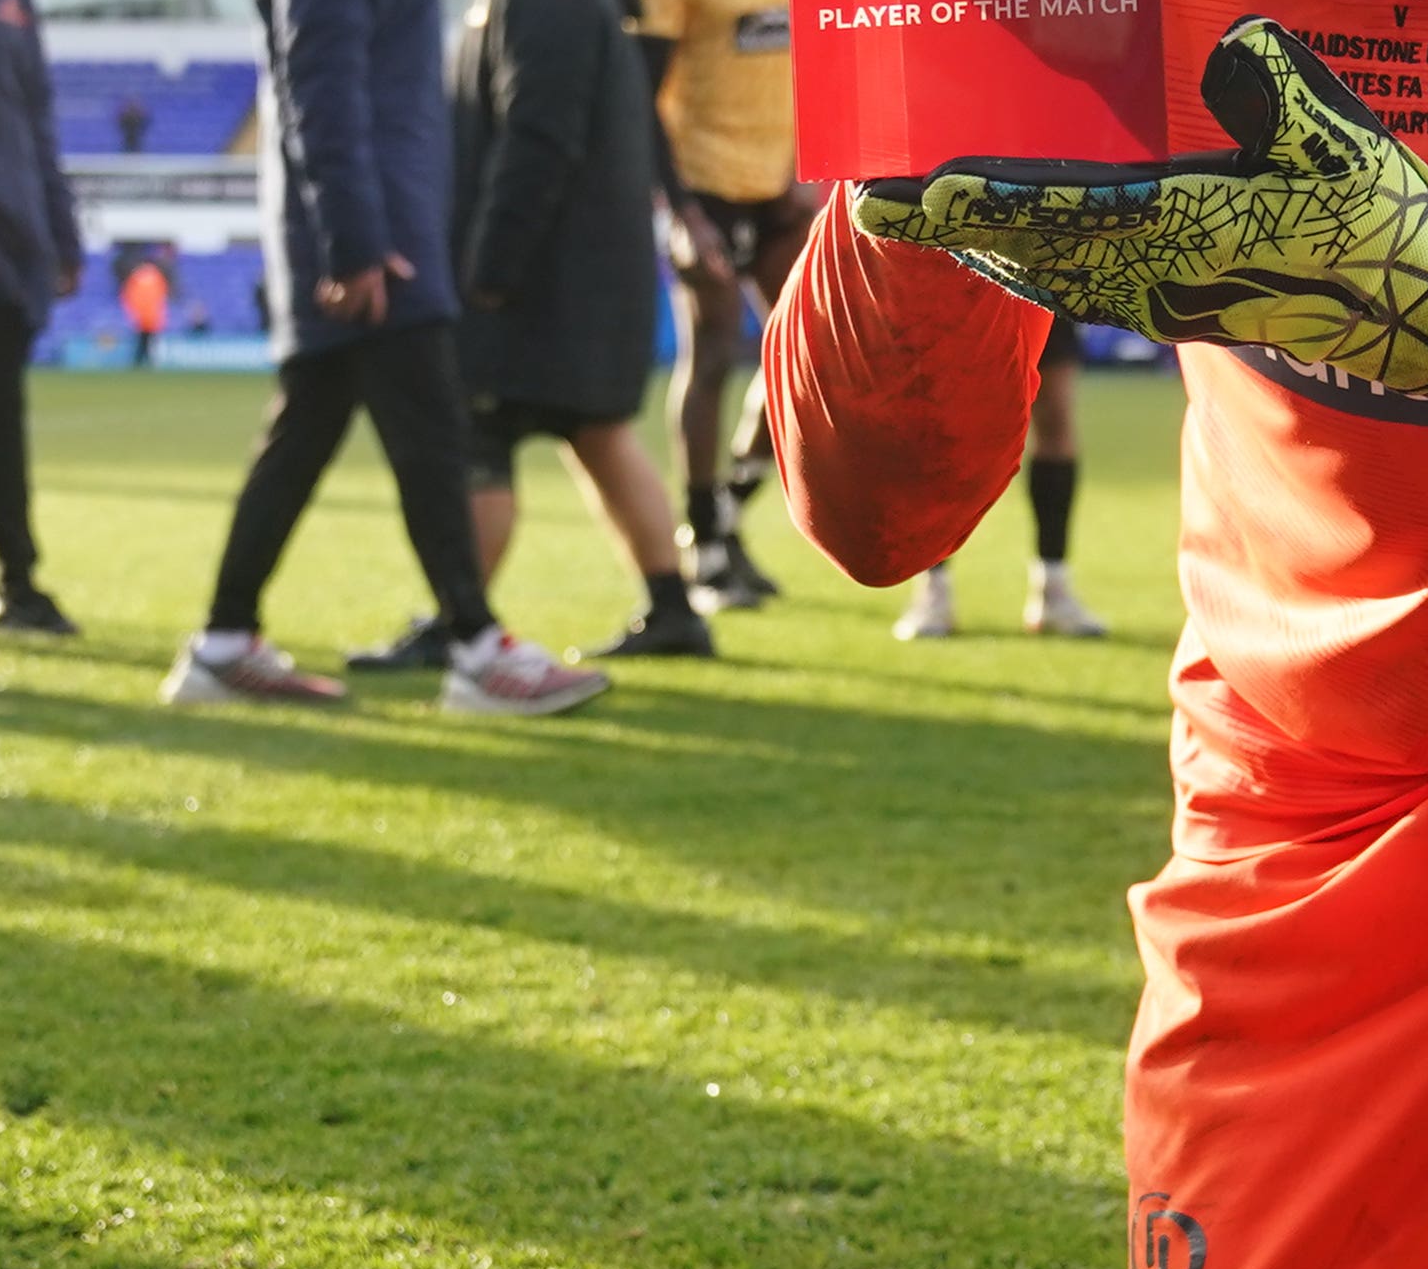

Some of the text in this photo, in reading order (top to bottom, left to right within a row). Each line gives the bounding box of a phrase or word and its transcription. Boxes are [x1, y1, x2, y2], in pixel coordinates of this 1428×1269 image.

[818, 3, 922, 30] PLAYER
[930, 1, 969, 24] OF
[1393, 4, 1409, 28] V
[1339, 71, 1392, 97] ATES
[1396, 76, 1422, 99] FA
